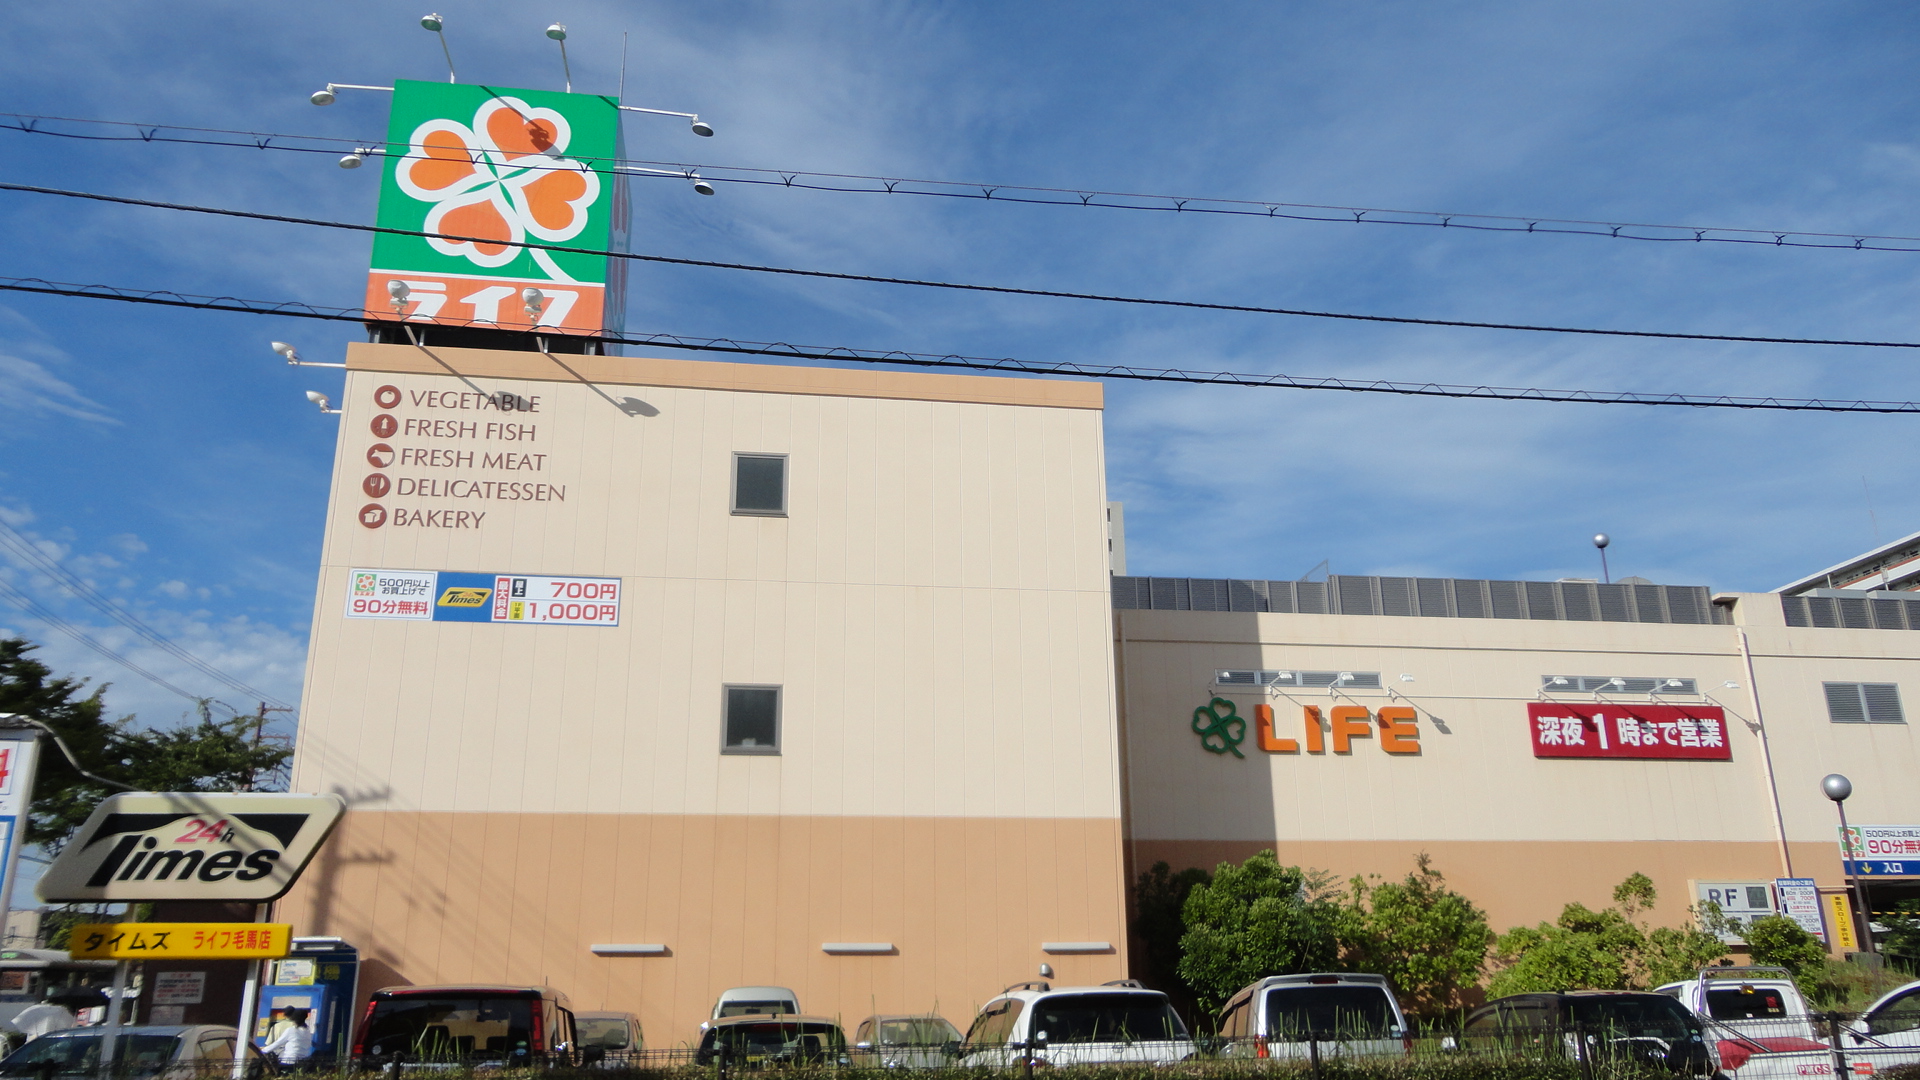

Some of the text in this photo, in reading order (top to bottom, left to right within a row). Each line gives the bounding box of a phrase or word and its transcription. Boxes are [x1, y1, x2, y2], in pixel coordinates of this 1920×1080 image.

[388, 280, 579, 328] ライフ
[410, 389, 541, 413] VEGETABLE
[404, 418, 536, 442] FRESH FISH
[400, 448, 547, 471] FRESH MEAT
[397, 477, 566, 502] DELICATESSEN
[393, 508, 486, 529] BAKERY
[379, 578, 431, 588] 500円以上
[550, 582, 617, 600] 700円
[353, 598, 428, 615] 90分無料
[447, 594, 482, 604] Times
[529, 602, 616, 621] 1,000円
[1254, 703, 1420, 754] LIFE
[1537, 712, 1723, 750] 深夜1時まで営業
[1868, 840, 1920, 854] 90分無
[85, 834, 280, 887] Times
[1883, 862, 1903, 873] 入口
[1708, 889, 1737, 907] RF
[84, 932, 170, 951] タイムズ
[193, 930, 271, 950] ライフ毛馬店
